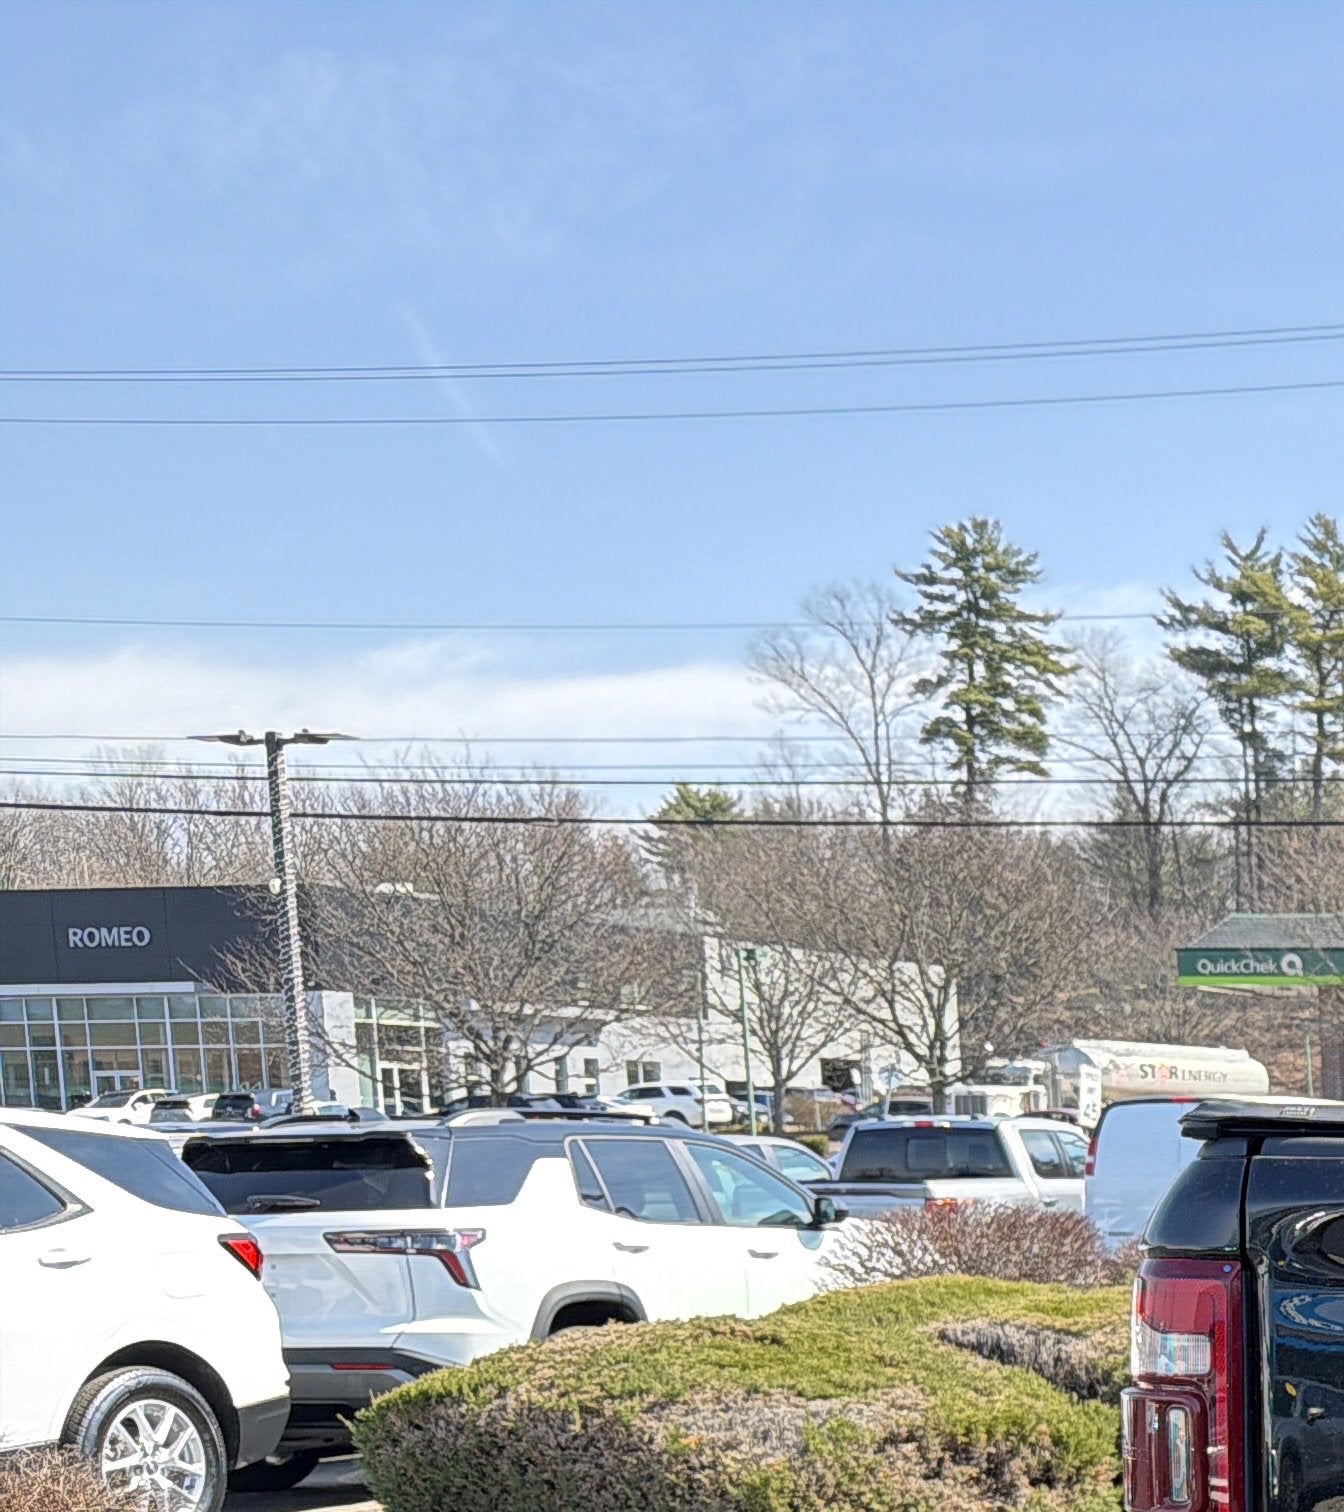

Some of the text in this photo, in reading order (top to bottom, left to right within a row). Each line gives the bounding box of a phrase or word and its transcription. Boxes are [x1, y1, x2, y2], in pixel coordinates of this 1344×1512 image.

[68, 926, 151, 948] ROMEO
[1197, 958, 1277, 975] QuickChek
[1182, 1068, 1228, 1083] ENERGY
